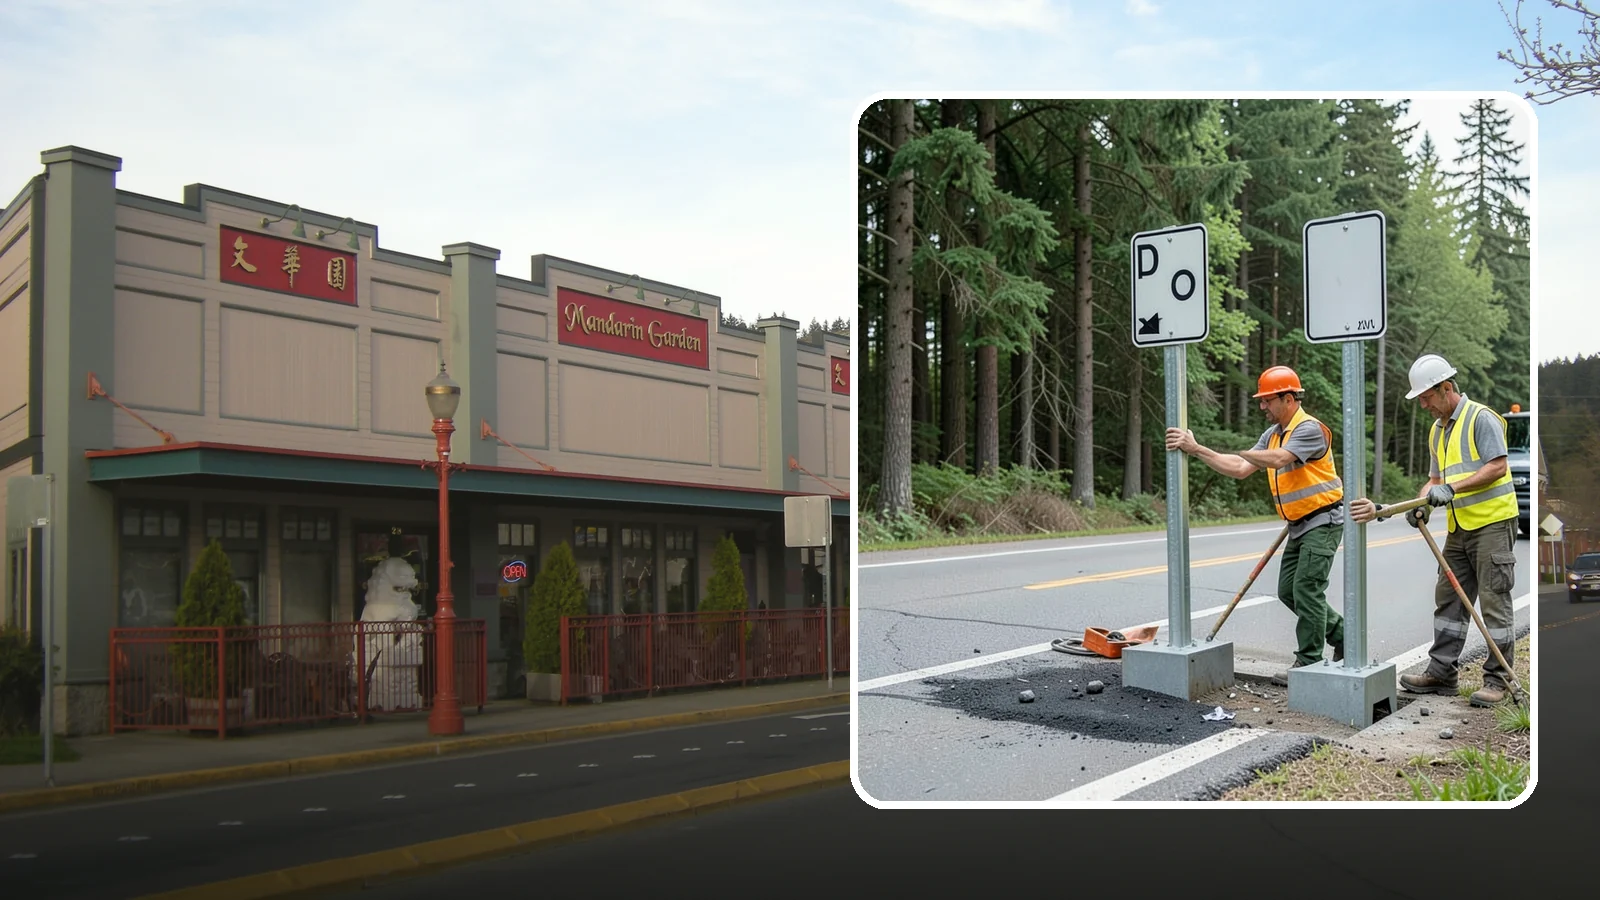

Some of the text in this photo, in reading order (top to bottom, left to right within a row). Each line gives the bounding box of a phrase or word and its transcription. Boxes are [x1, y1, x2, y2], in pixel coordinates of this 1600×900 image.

[231, 235, 346, 291] 文華園
[564, 302, 702, 352] Mandarin Garden
[503, 565, 527, 578] OPEN
